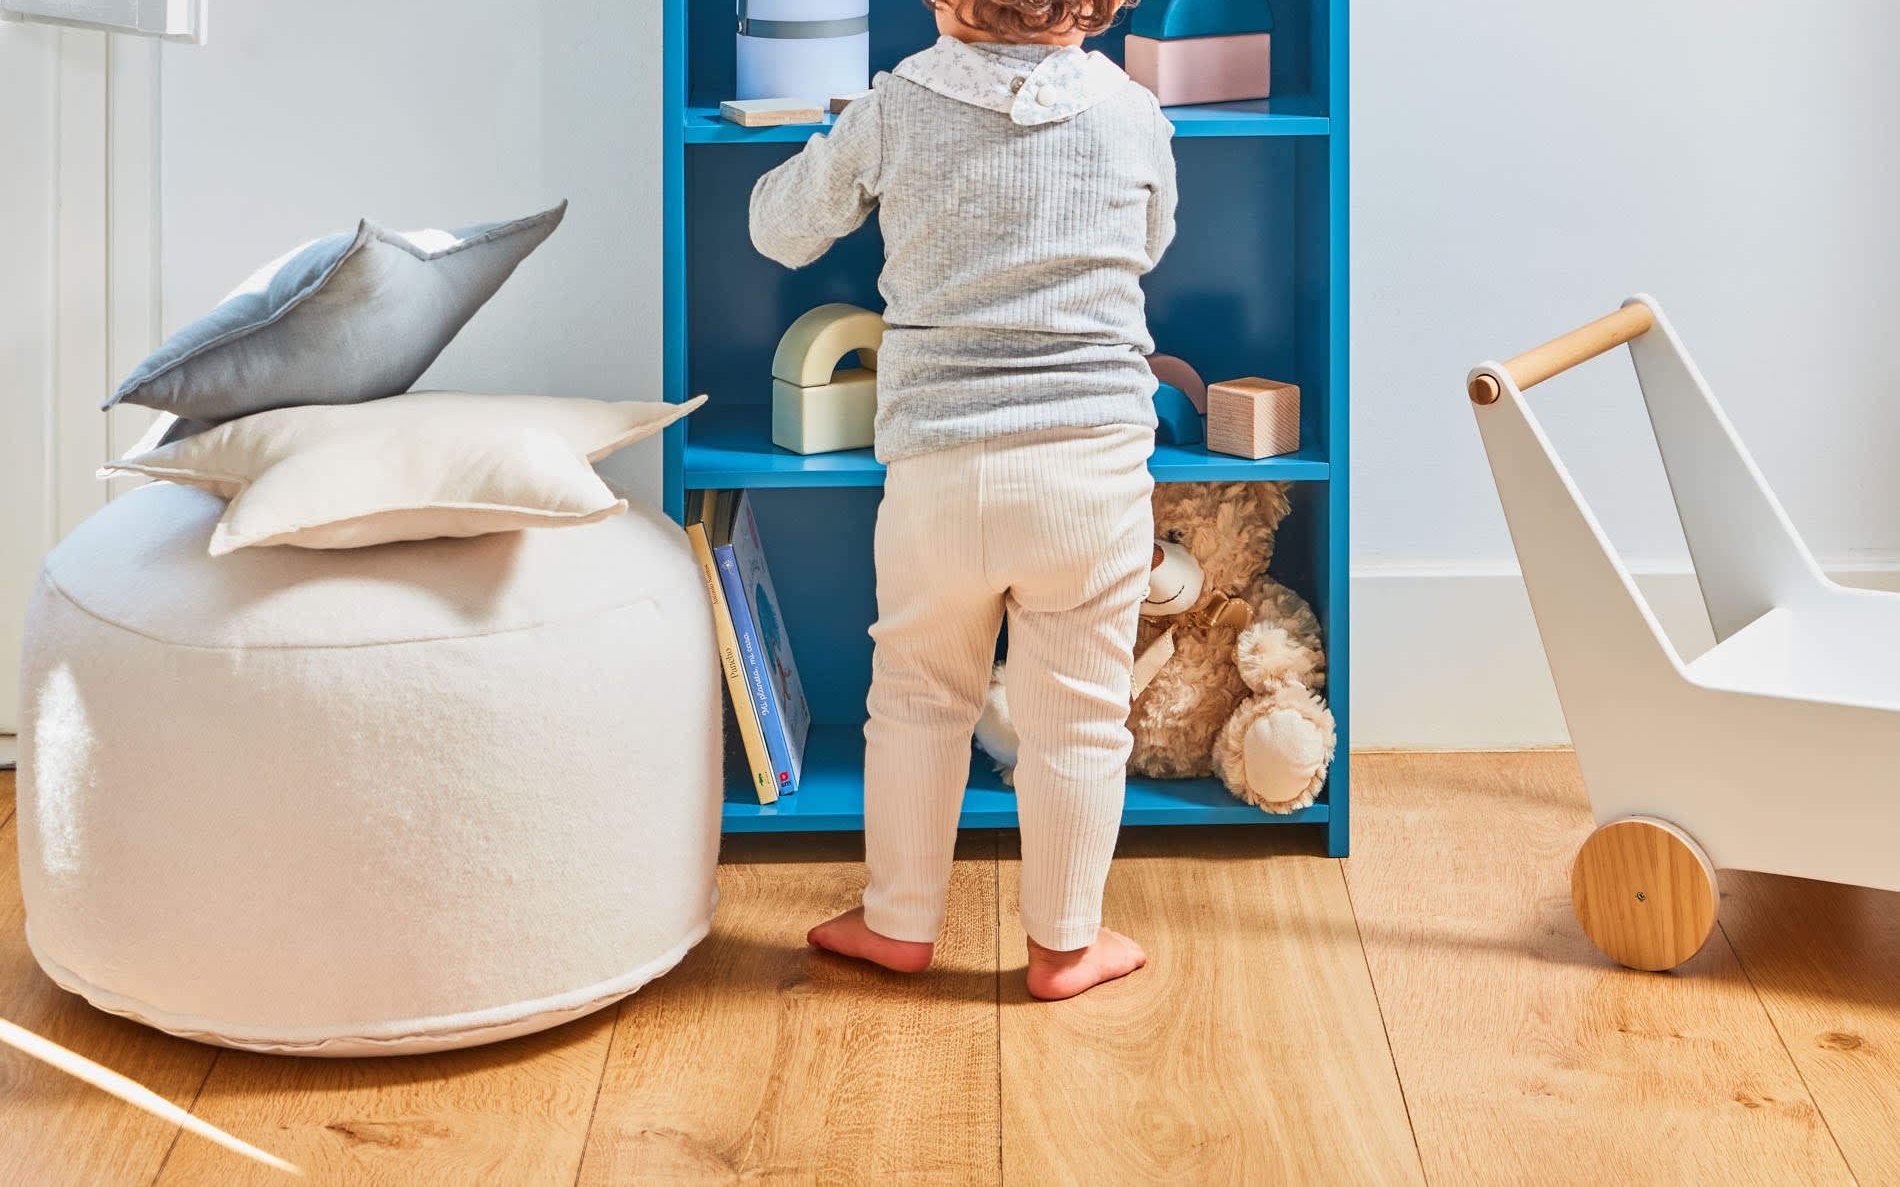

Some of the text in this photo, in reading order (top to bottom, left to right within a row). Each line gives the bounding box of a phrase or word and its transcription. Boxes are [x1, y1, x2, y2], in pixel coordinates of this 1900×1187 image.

[726, 647, 739, 679] Pancho
[748, 653, 755, 665] mi
[760, 701, 770, 716] Mi
